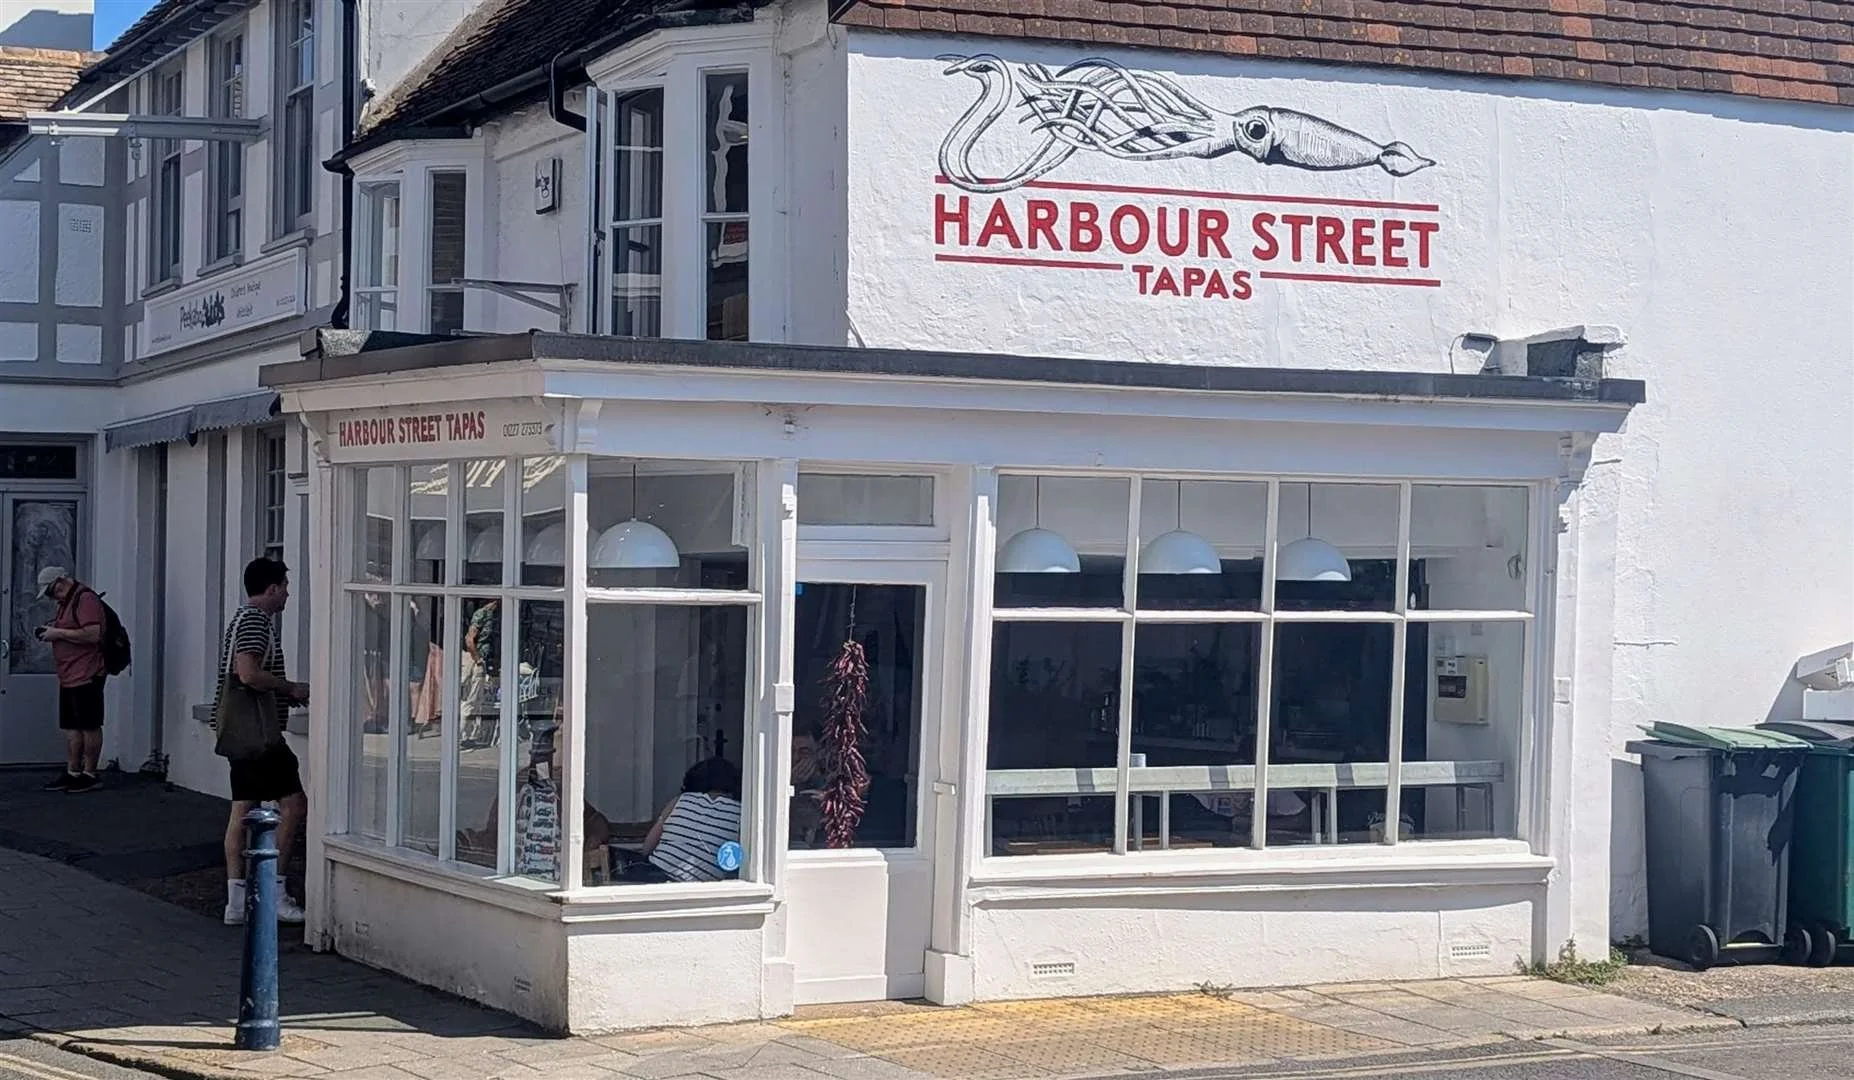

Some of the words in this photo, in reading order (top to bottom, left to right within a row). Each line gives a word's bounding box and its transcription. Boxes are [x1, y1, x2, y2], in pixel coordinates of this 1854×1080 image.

[934, 193, 1232, 259] HARBOUR
[1252, 211, 1440, 269] STREET
[1132, 264, 1252, 300] TAPAS
[339, 414, 396, 447] HARBOUR
[398, 414, 442, 444] STREET
[446, 410, 486, 442] TAPAS
